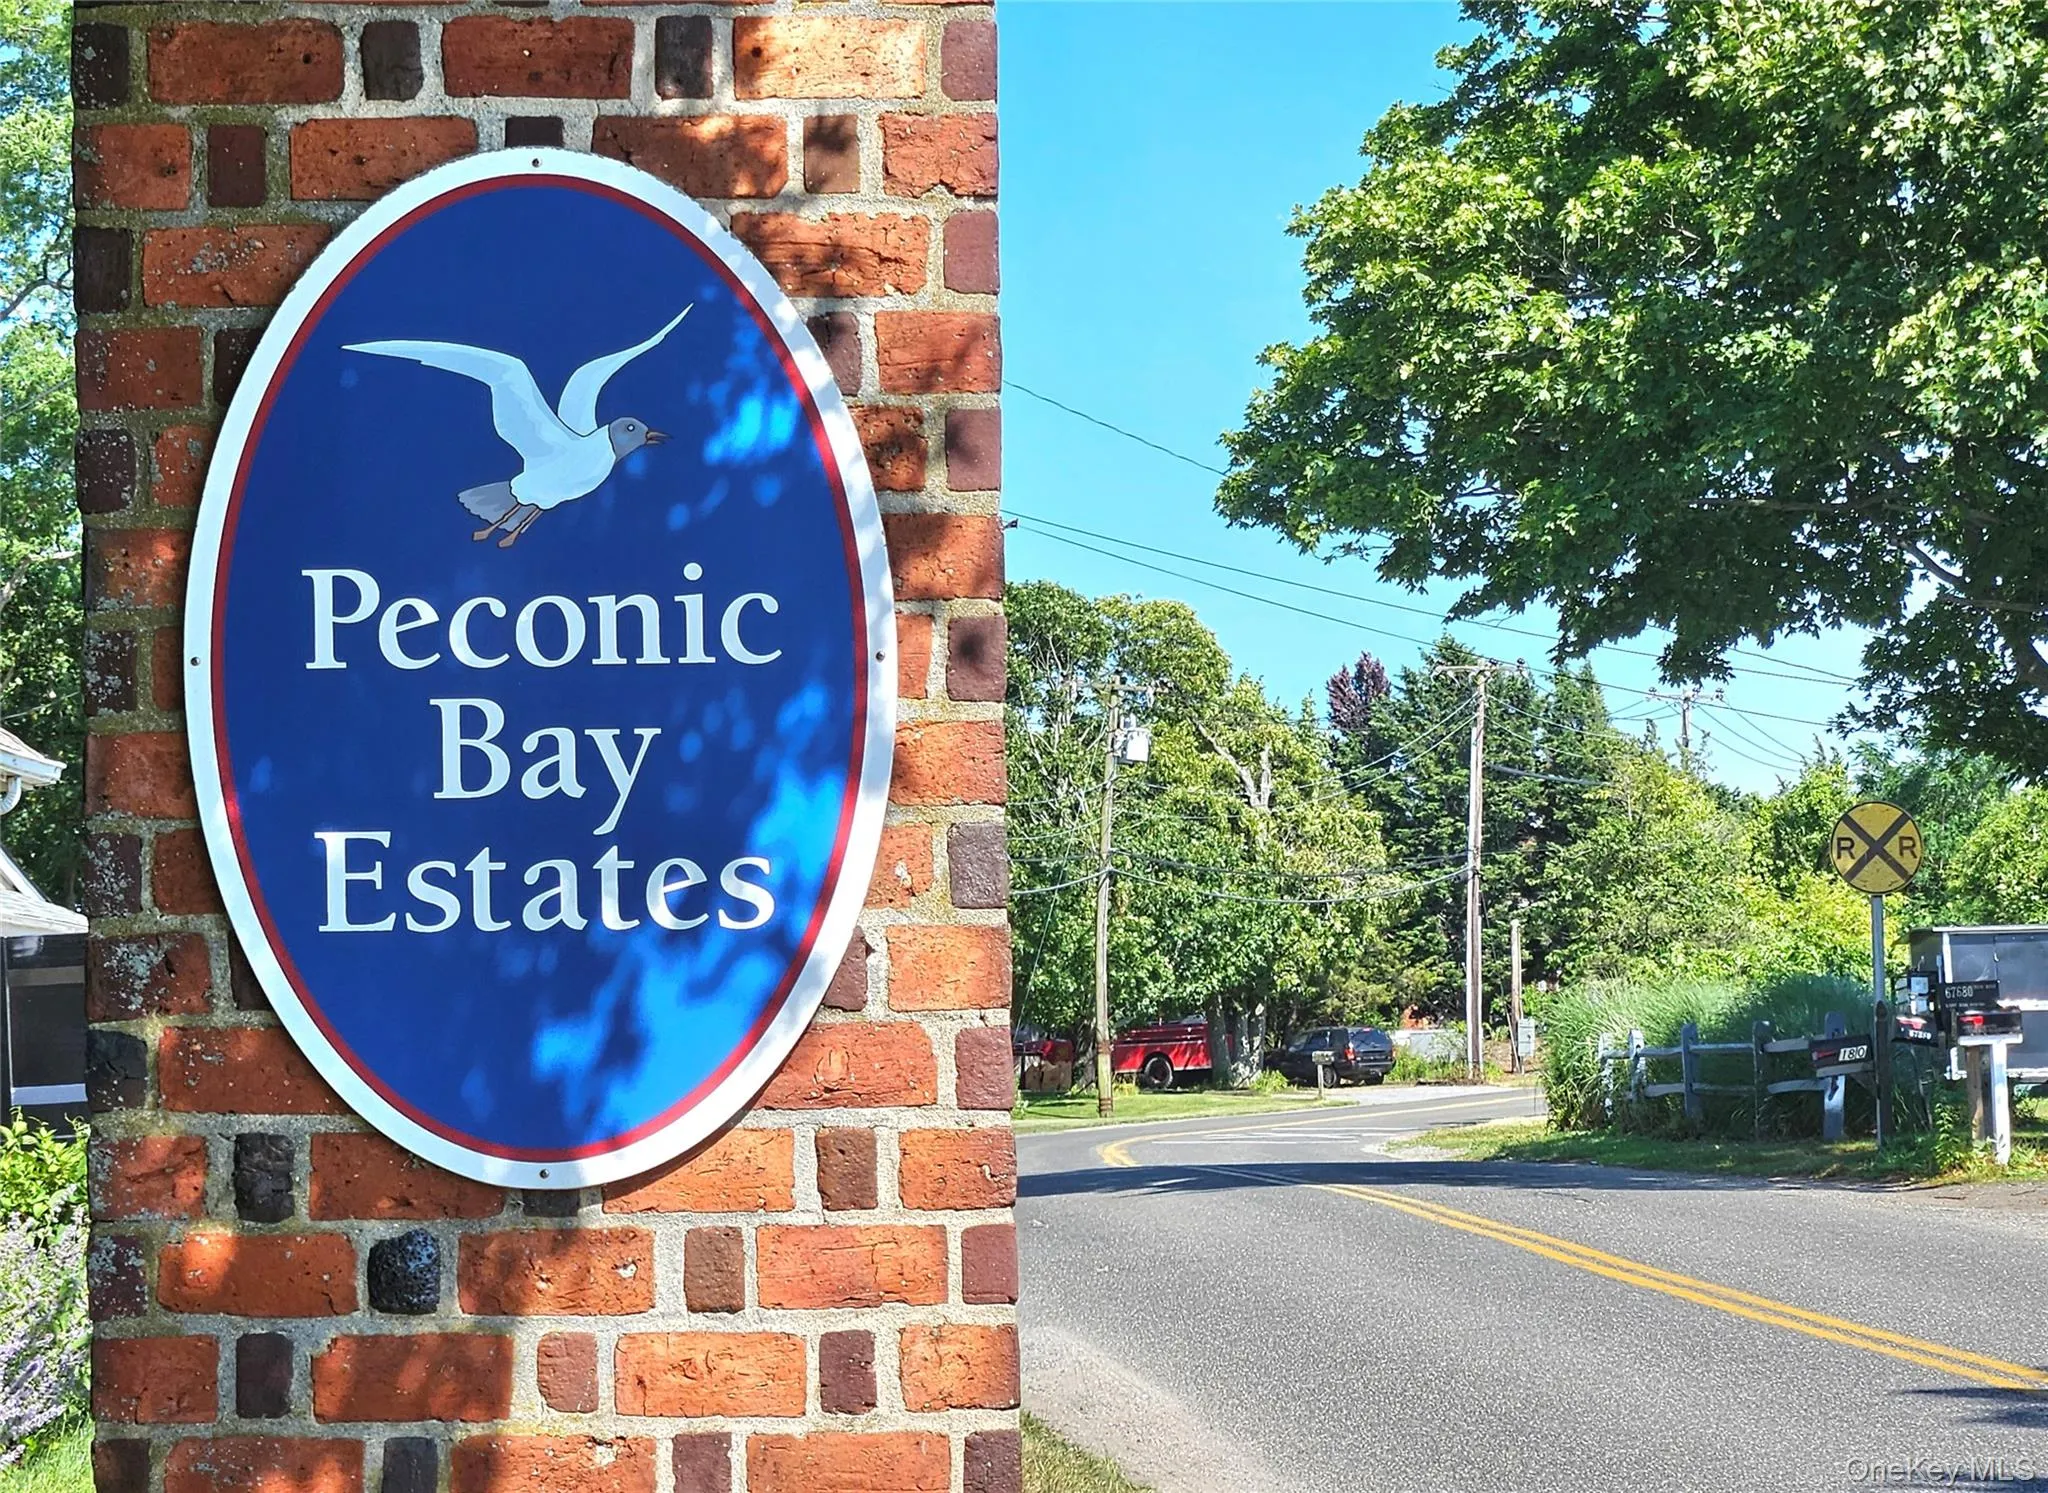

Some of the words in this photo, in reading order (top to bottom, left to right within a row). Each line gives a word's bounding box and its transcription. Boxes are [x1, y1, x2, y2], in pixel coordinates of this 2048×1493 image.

[302, 562, 782, 670] Peconic
[430, 698, 662, 835] Bay
[1836, 836, 1855, 860] R
[1898, 835, 1917, 859] R
[314, 831, 776, 932] Estates
[1945, 985, 1973, 999] 67680
[1842, 1047, 1866, 1060] 180
